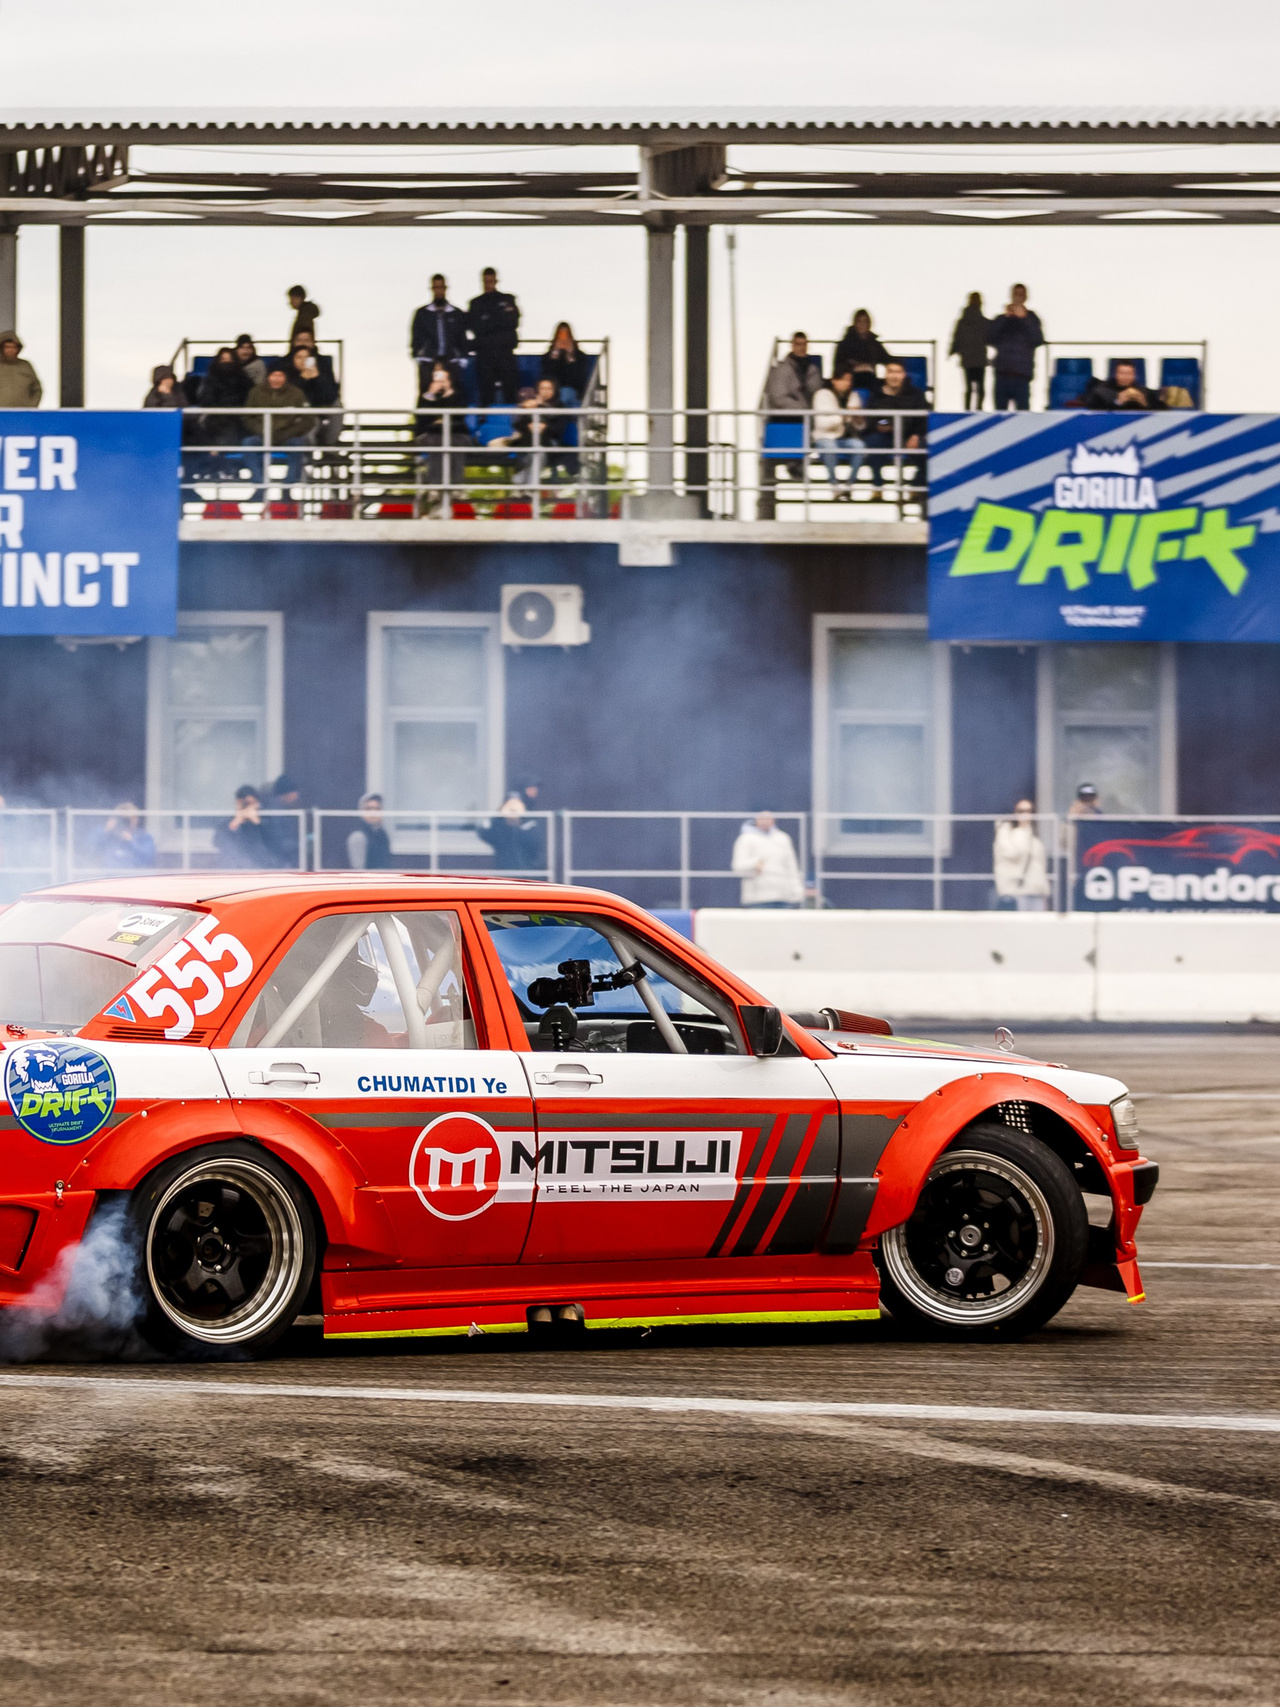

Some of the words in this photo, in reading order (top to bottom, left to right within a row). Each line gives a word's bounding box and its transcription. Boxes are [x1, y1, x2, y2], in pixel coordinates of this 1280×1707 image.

[1054, 476, 1158, 510] GORILLA
[126, 914, 254, 1040] 555
[61, 1072, 95, 1086] GORILLA
[357, 1075, 475, 1094] CHUMATIDI
[482, 1077, 508, 1094] Ye
[48, 1121, 70, 1129] ULTIMATE
[51, 1125, 82, 1133] TOURNAMENT
[510, 1139, 731, 1175] MITSUJI
[546, 1184, 592, 1193] FEEL
[599, 1184, 632, 1193] THE
[640, 1183, 701, 1193] JAPAN
